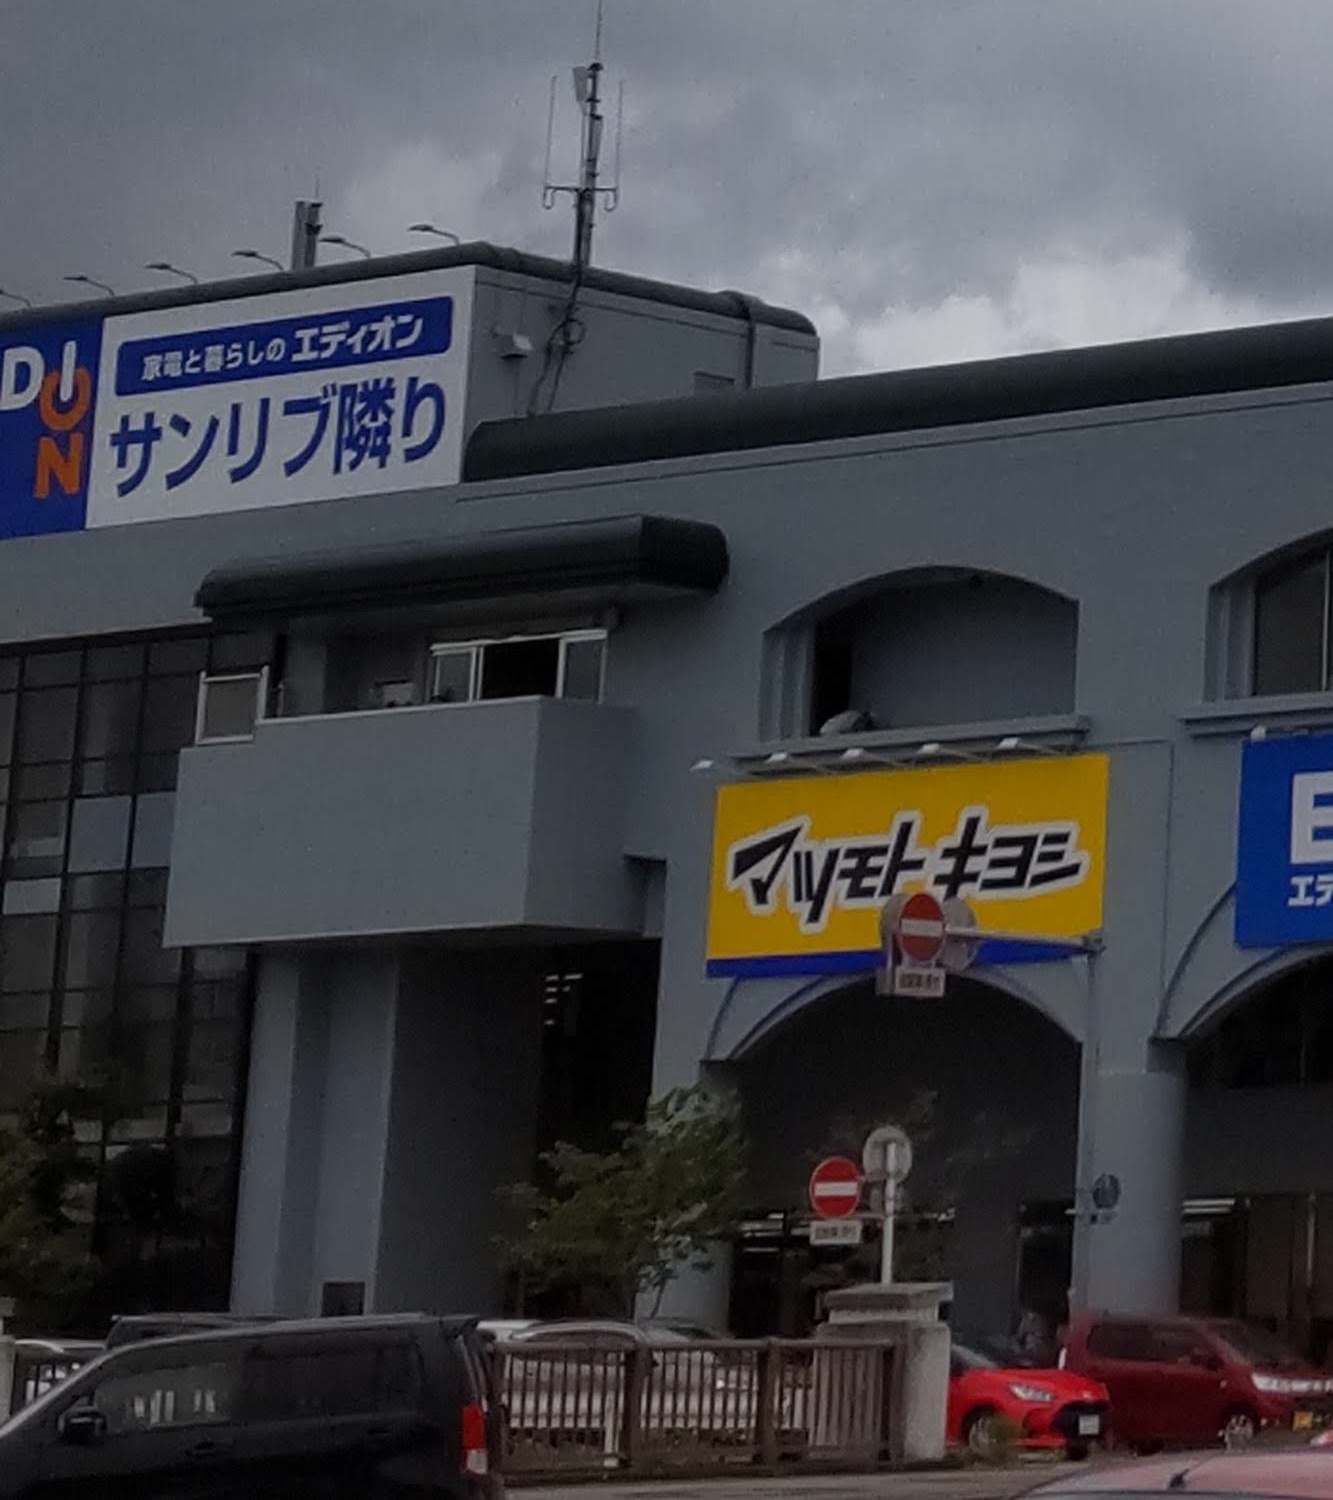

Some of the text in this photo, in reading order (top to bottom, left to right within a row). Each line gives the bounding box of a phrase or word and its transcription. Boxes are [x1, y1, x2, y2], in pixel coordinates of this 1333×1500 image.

[141, 313, 424, 382] 家電と暮らしの エディオン
[110, 376, 446, 498] サンリブ隣り
